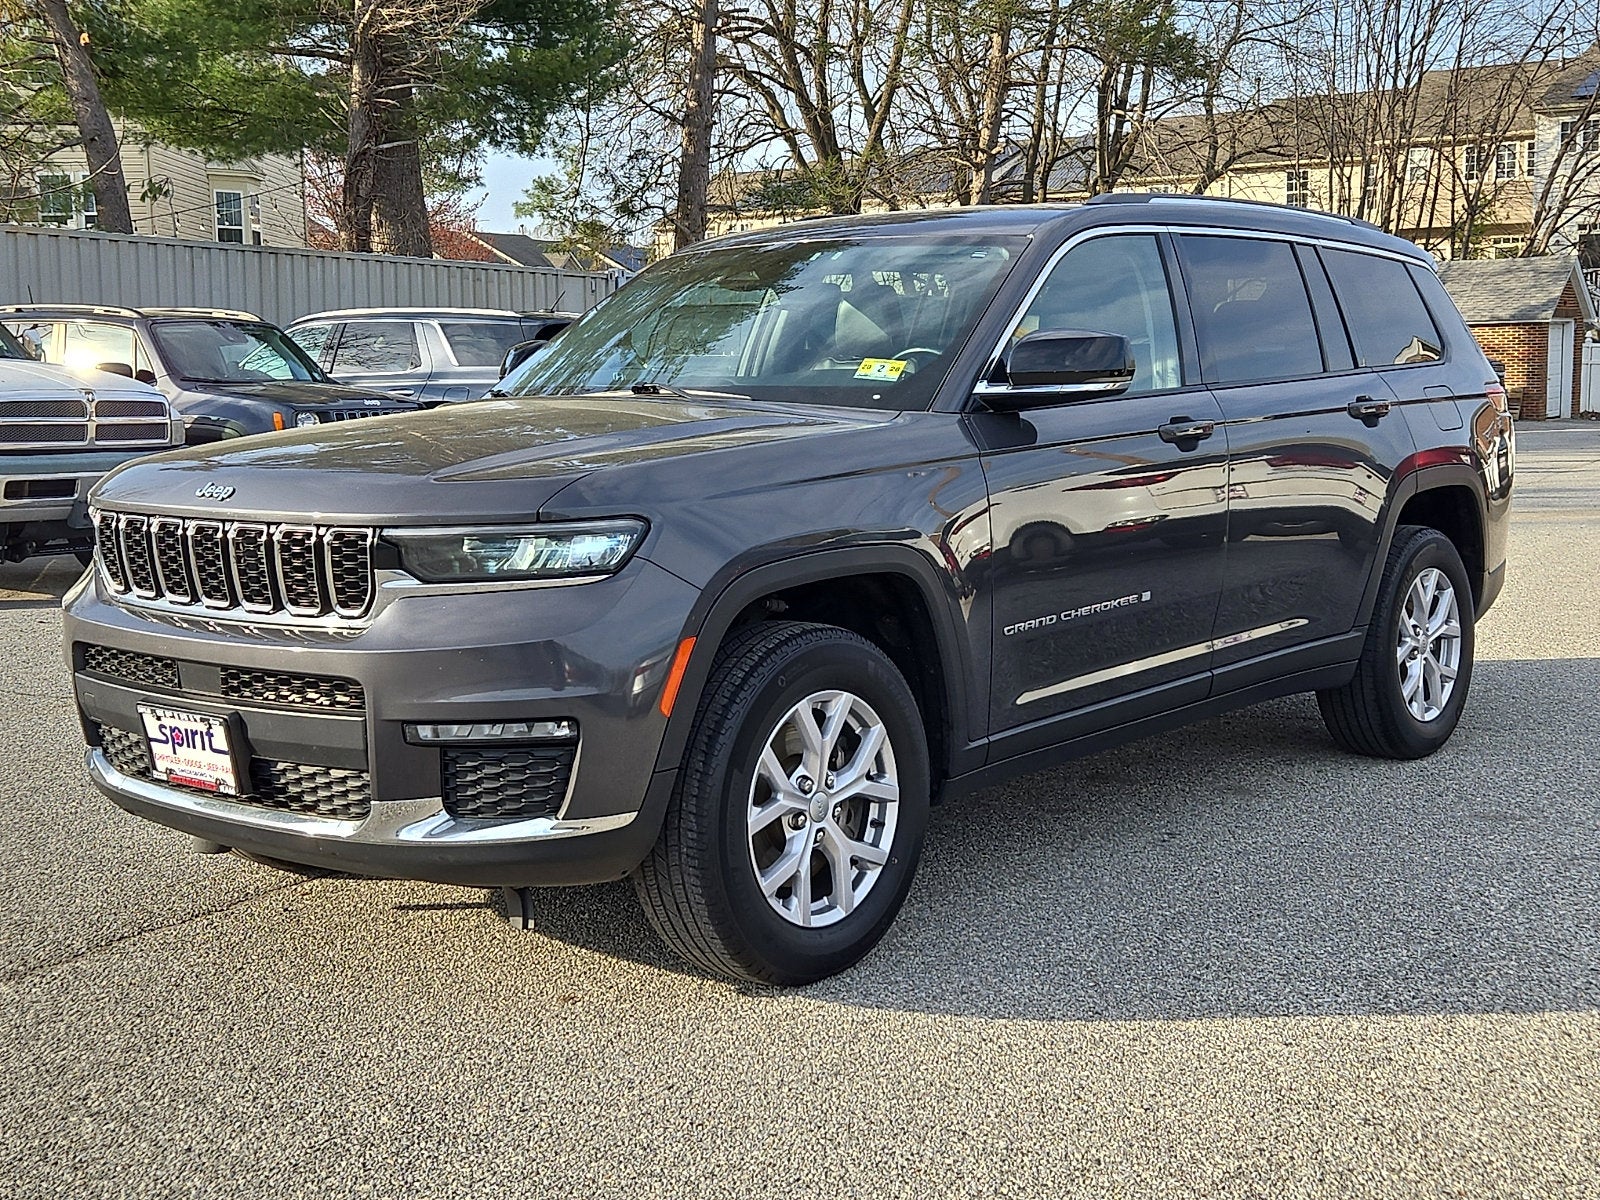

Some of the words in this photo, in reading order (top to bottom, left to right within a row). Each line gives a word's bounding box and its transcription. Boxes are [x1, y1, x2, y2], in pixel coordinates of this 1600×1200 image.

[877, 364, 886, 373] 2
[195, 481, 236, 502] Jeep
[1003, 614, 1058, 636] GRAND
[1060, 594, 1139, 622] CHEROKEE
